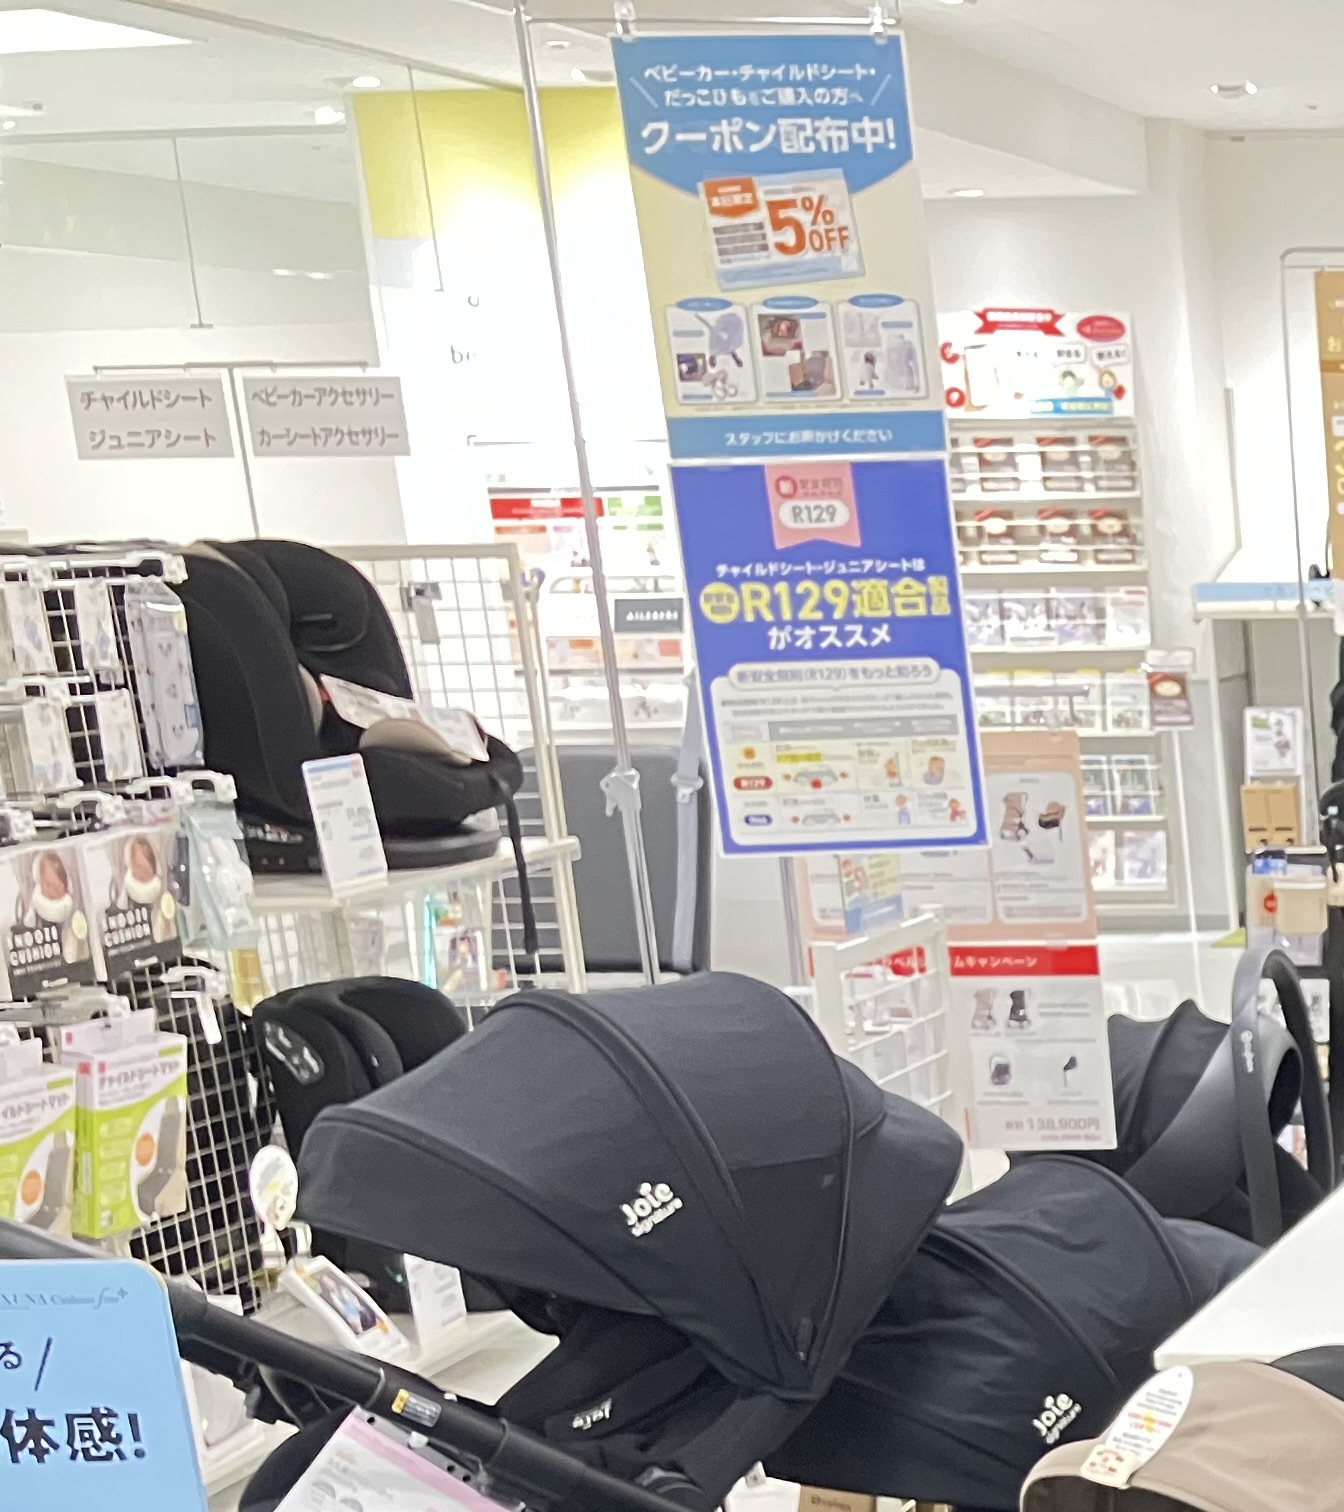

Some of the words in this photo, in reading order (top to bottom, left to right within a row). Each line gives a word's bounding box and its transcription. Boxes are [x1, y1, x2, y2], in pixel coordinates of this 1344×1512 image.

[641, 116, 896, 155] クーポン配布中!
[809, 226, 849, 253] OFF
[80, 389, 213, 411] チャイルドシート
[251, 386, 395, 407] ベビーカーアクセサリー
[89, 427, 217, 450] ジュニアシート
[258, 425, 399, 447] カーシートアクセサリー
[791, 504, 837, 524] R129
[768, 624, 892, 650] がオススメ
[620, 1182, 676, 1228] Joie
[1032, 1392, 1074, 1438] Joie
[1, 1406, 146, 1464] 体感!
